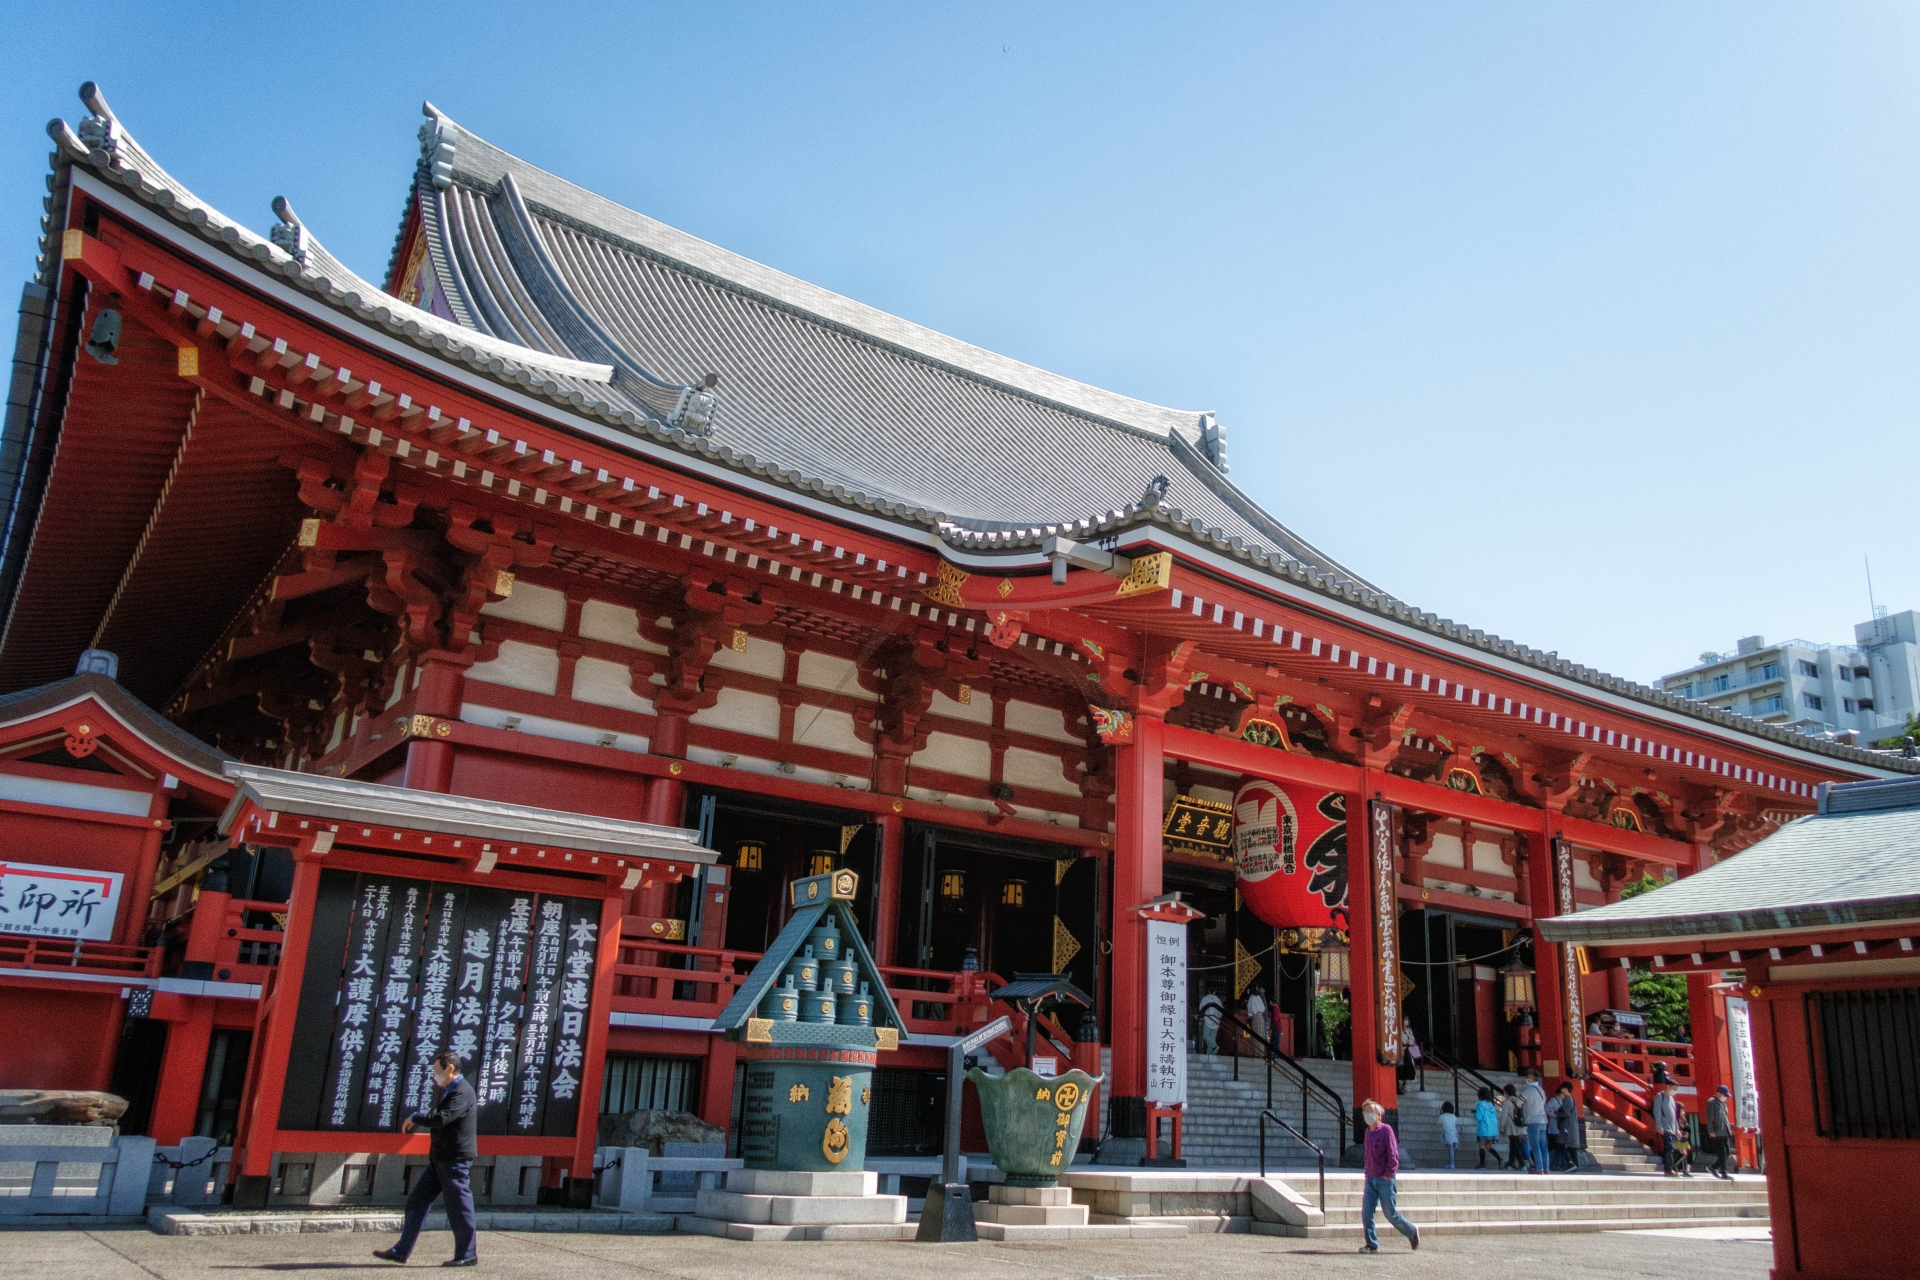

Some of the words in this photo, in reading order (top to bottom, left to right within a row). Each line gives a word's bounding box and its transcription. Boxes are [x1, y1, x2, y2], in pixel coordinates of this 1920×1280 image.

[1281, 815, 1296, 874] 東京新橋組合
[1155, 934, 1180, 947] 恒例
[449, 928, 491, 1060] 連月法要
[551, 918, 598, 1100] 本堂連日法会
[1036, 1088, 1050, 1101] 納
